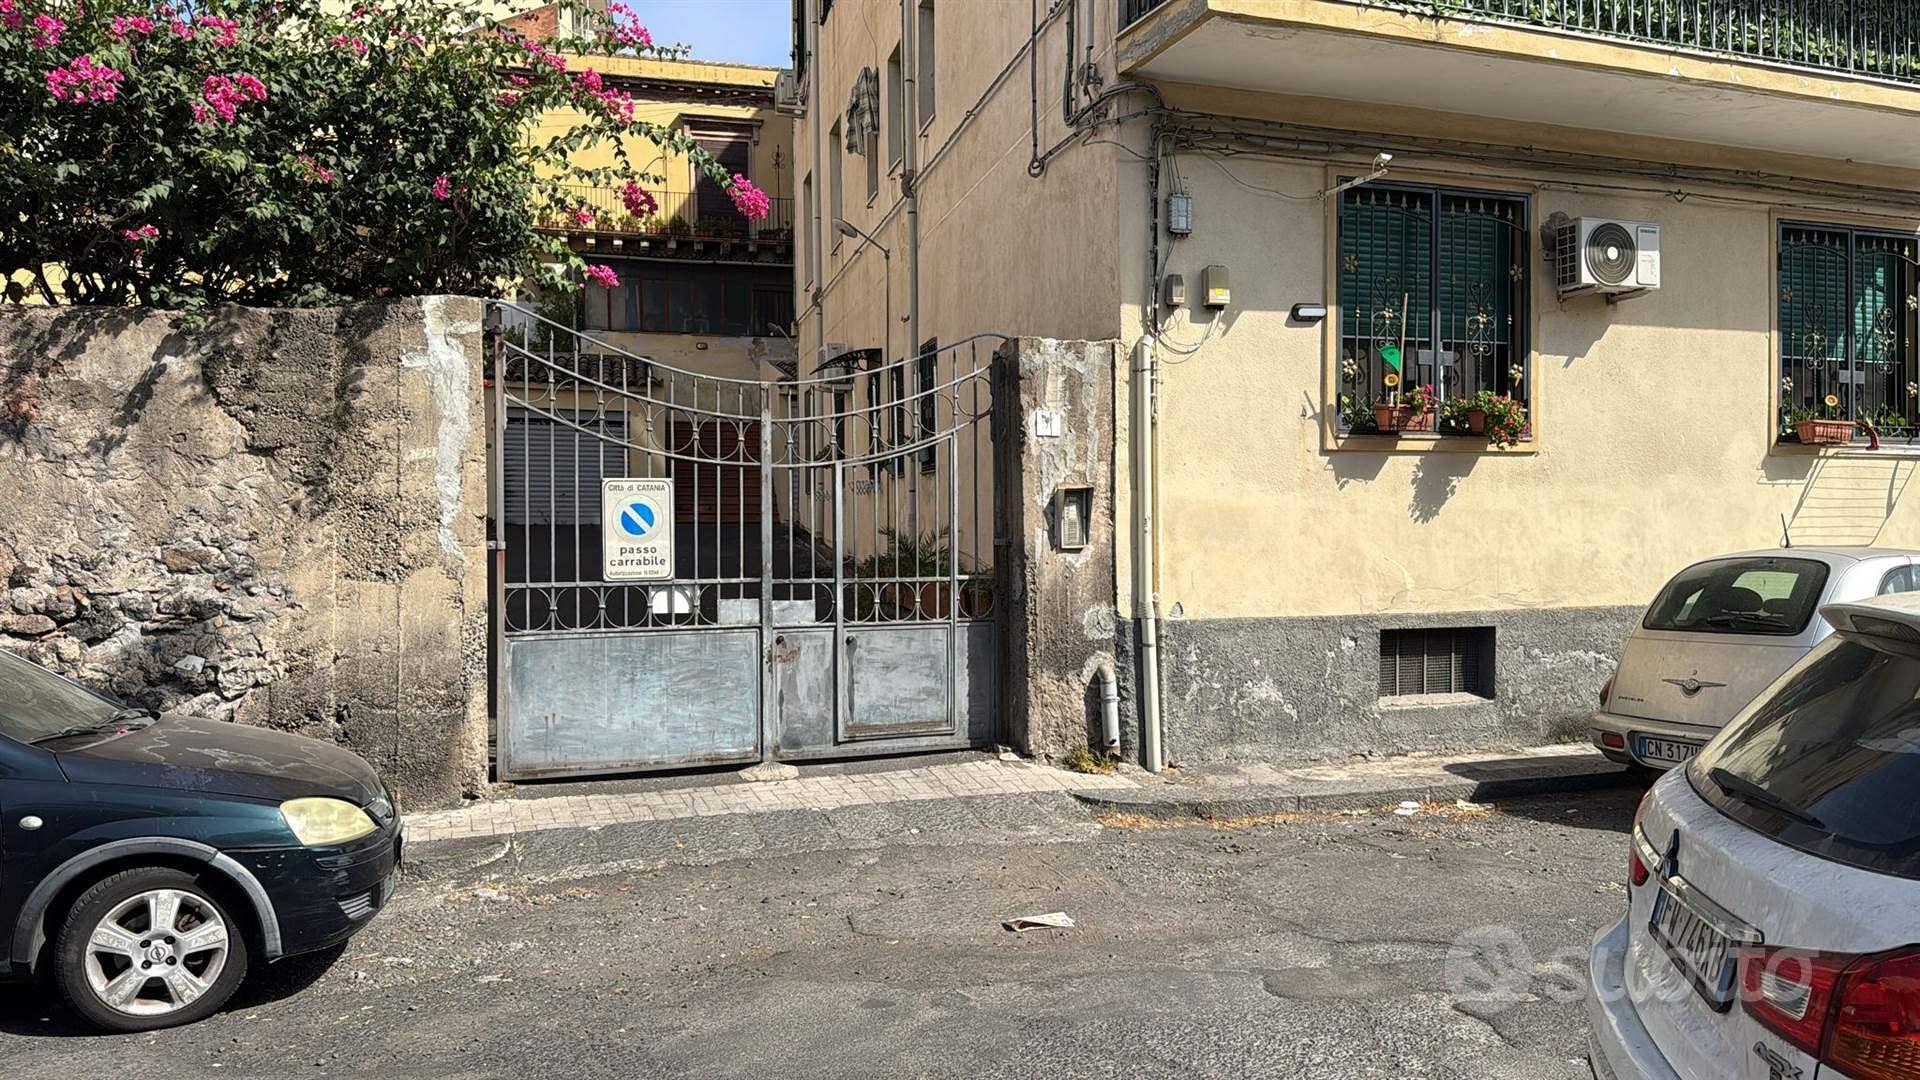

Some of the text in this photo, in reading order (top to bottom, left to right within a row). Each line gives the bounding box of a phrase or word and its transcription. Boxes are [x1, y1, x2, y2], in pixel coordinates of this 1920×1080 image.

[637, 484, 666, 492] CATANIA
[620, 546, 657, 556] passo
[609, 556, 666, 567] carrabile
[1647, 740, 1663, 757] CN
